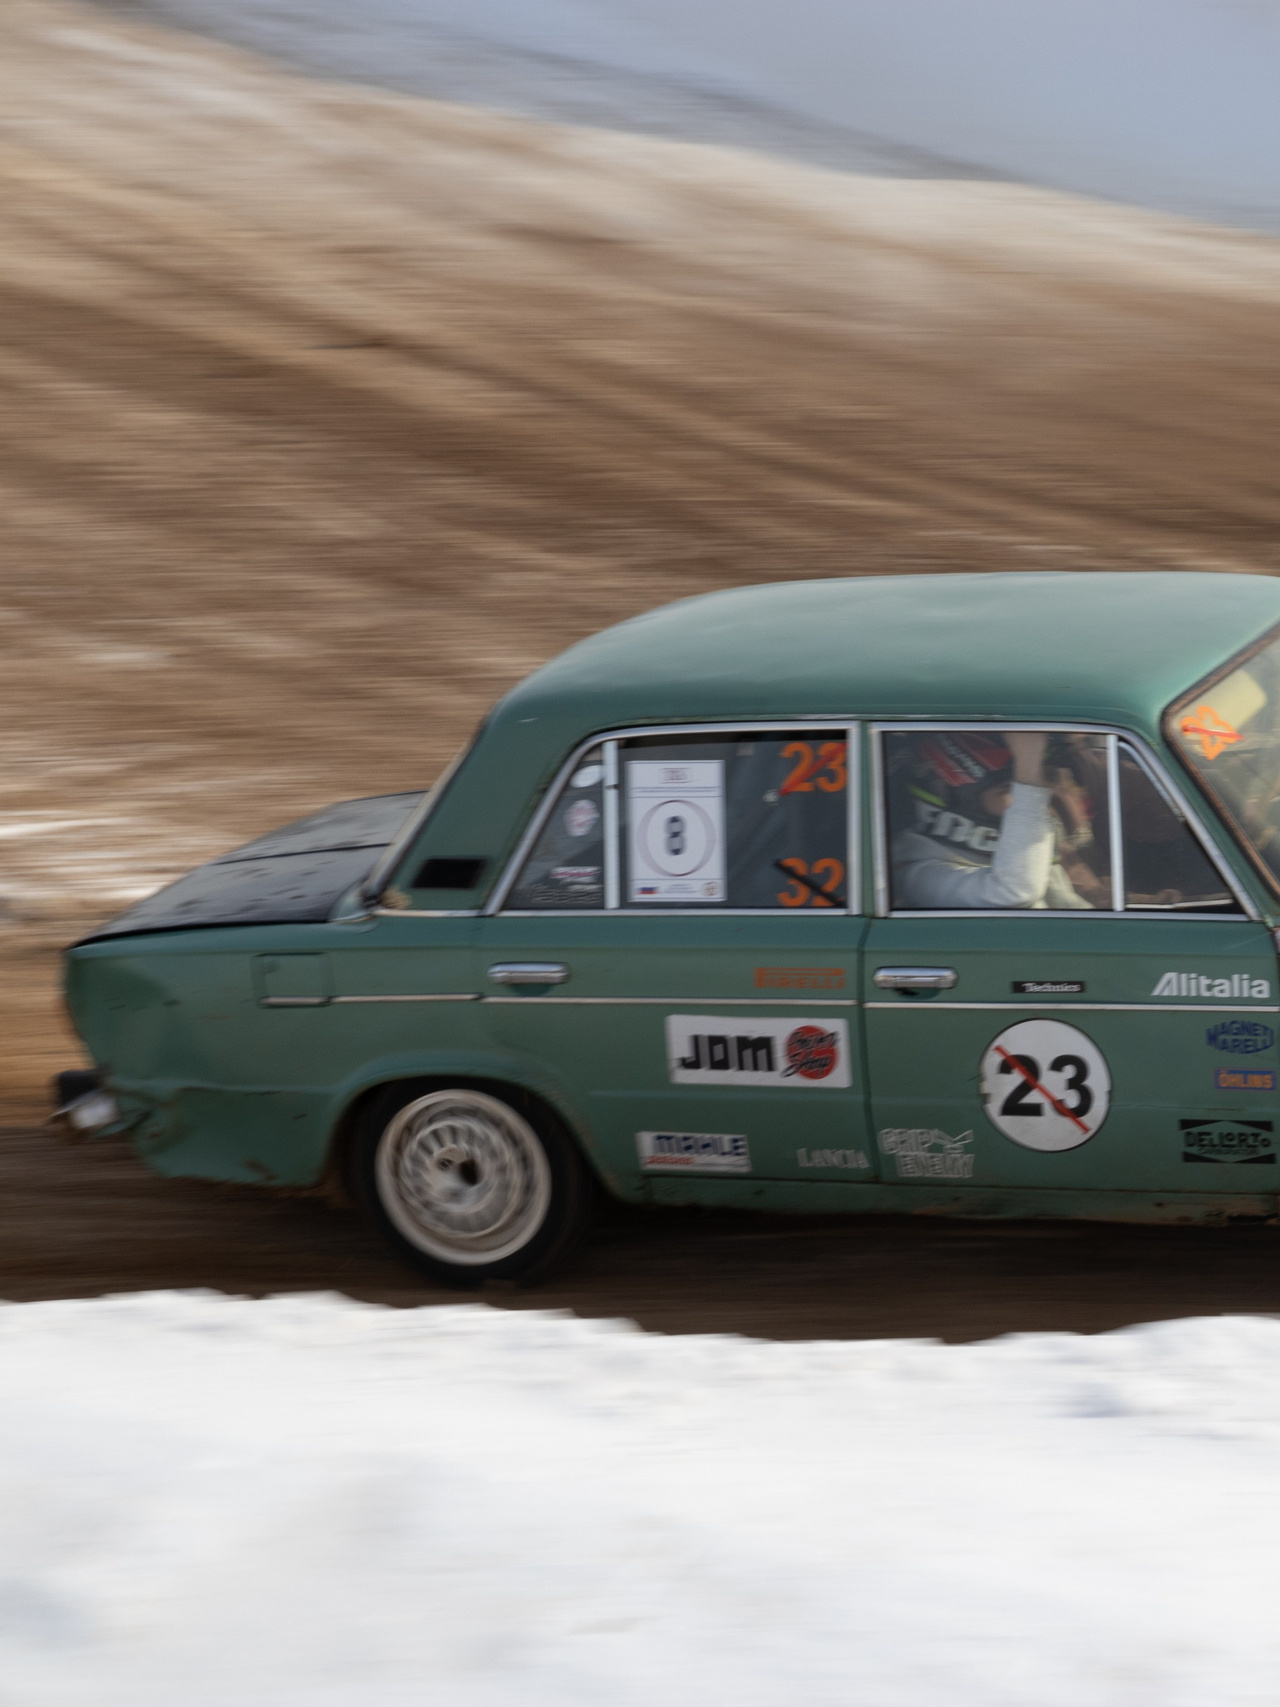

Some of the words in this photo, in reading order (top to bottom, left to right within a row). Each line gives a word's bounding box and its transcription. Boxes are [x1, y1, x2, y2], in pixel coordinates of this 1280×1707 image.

[780, 742, 847, 792] 23
[754, 967, 846, 989] PIRELLI
[1022, 981, 1082, 993] Technics
[1151, 972, 1271, 998] Alitalia
[678, 1034, 776, 1071] JDM
[996, 1054, 1094, 1119] 23
